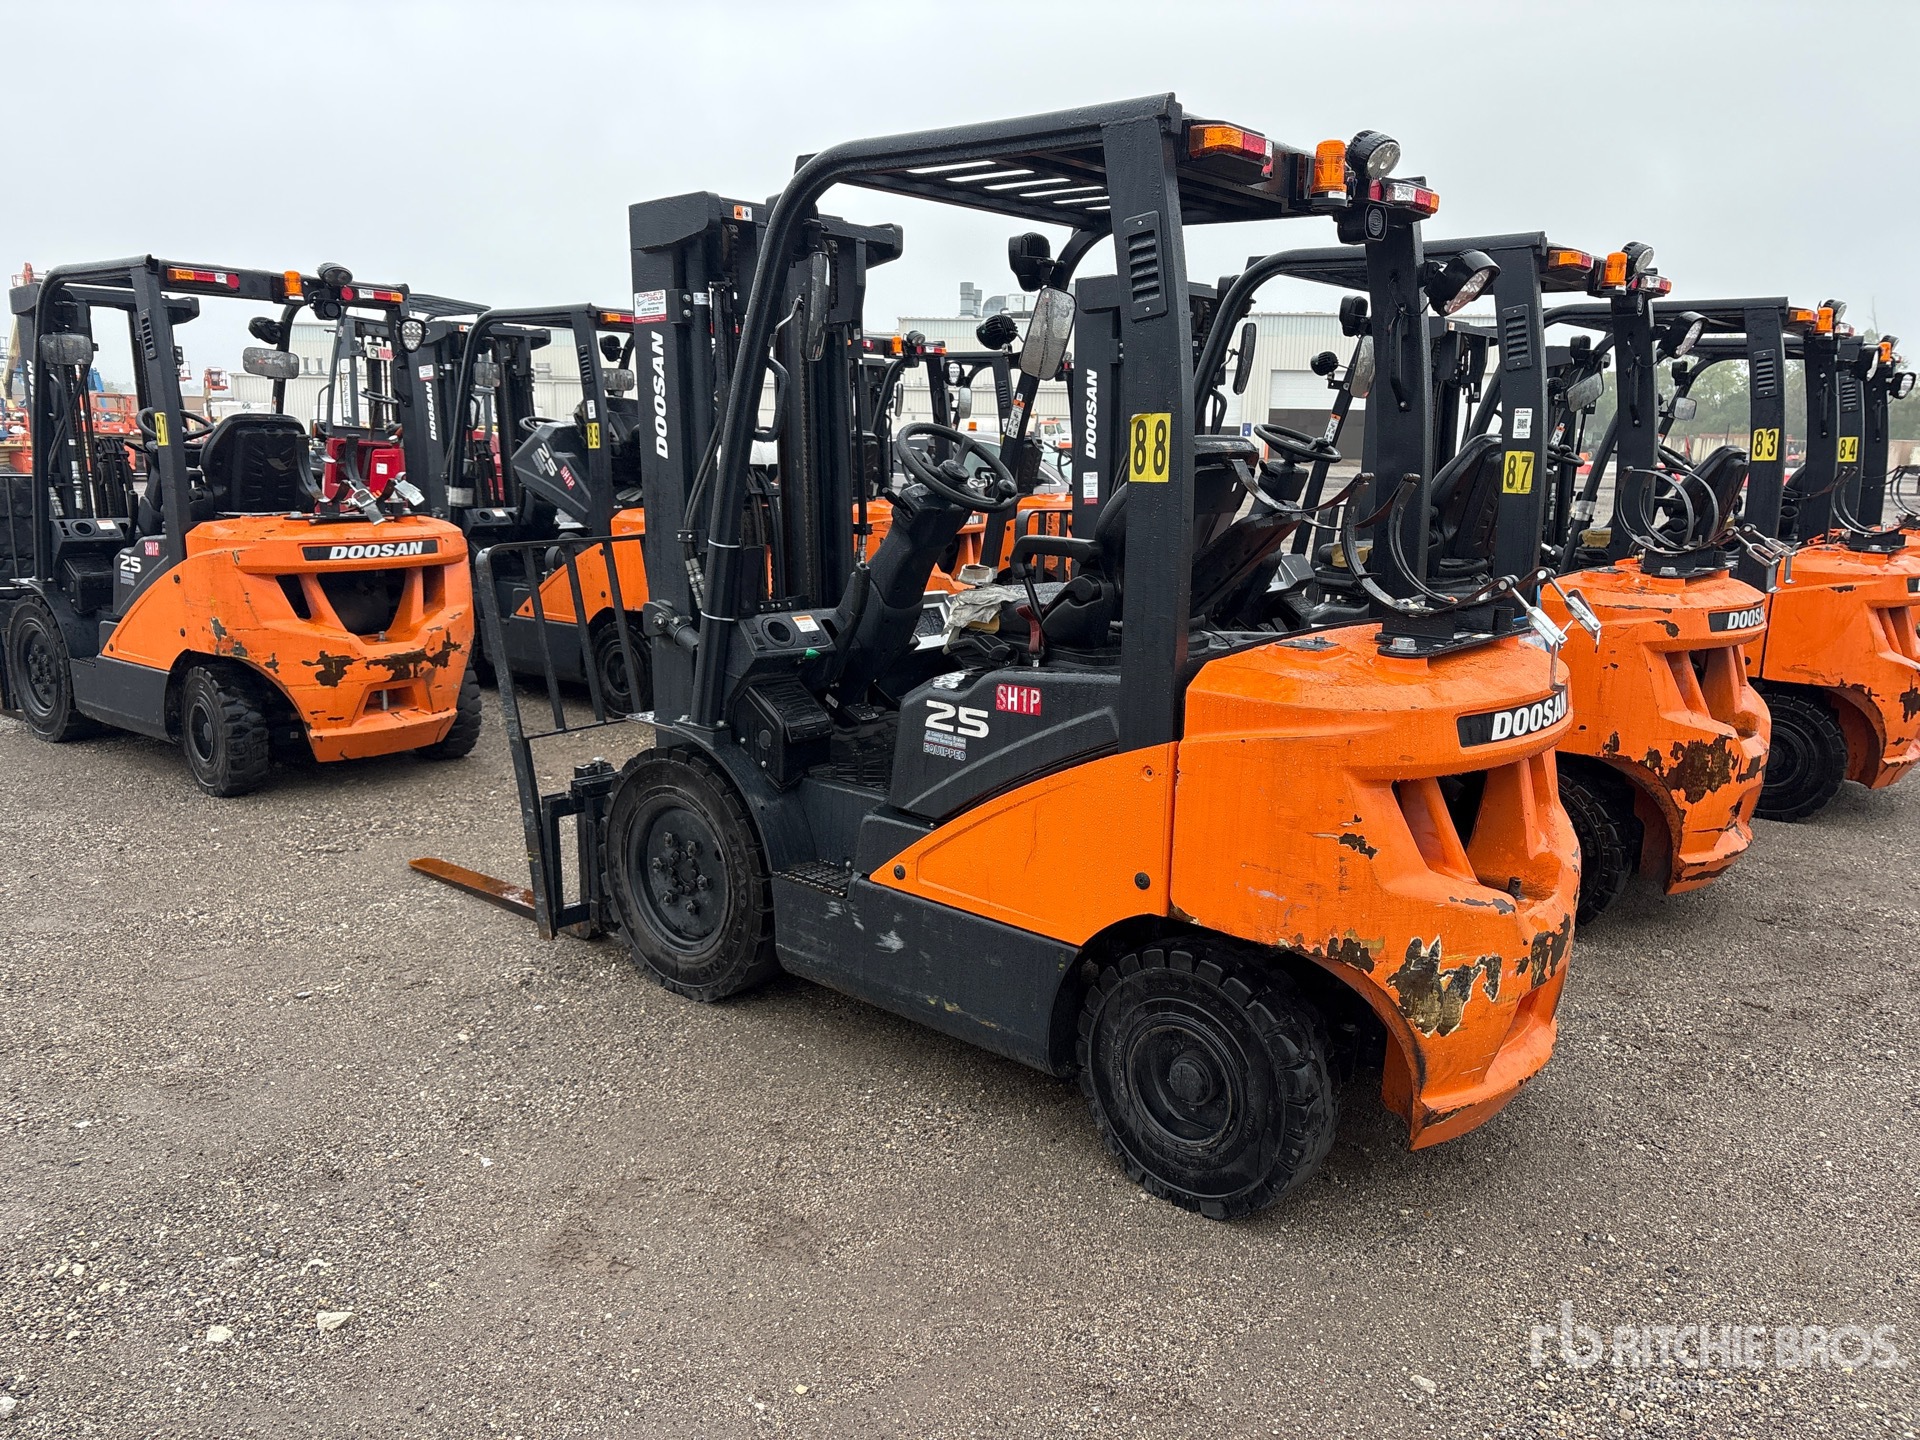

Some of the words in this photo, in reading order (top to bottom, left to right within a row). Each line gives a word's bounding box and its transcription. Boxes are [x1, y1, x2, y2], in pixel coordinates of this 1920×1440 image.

[425, 381, 437, 440] DOOSAN
[651, 330, 669, 460] DOOSAN
[1086, 369, 1098, 459] DOOSAN
[587, 425, 599, 446] 89
[1134, 419, 1167, 475] 88
[1754, 430, 1776, 457] 83
[1839, 438, 1857, 460] 84
[537, 443, 558, 477] 25
[1506, 454, 1533, 490] 87
[120, 554, 142, 573] 25
[328, 541, 423, 560] DOOSAN
[1727, 605, 1764, 629] DOOSA
[925, 699, 990, 738] 25
[1491, 690, 1566, 741] DOOSAN
[923, 742, 967, 761] EQUIPPED
